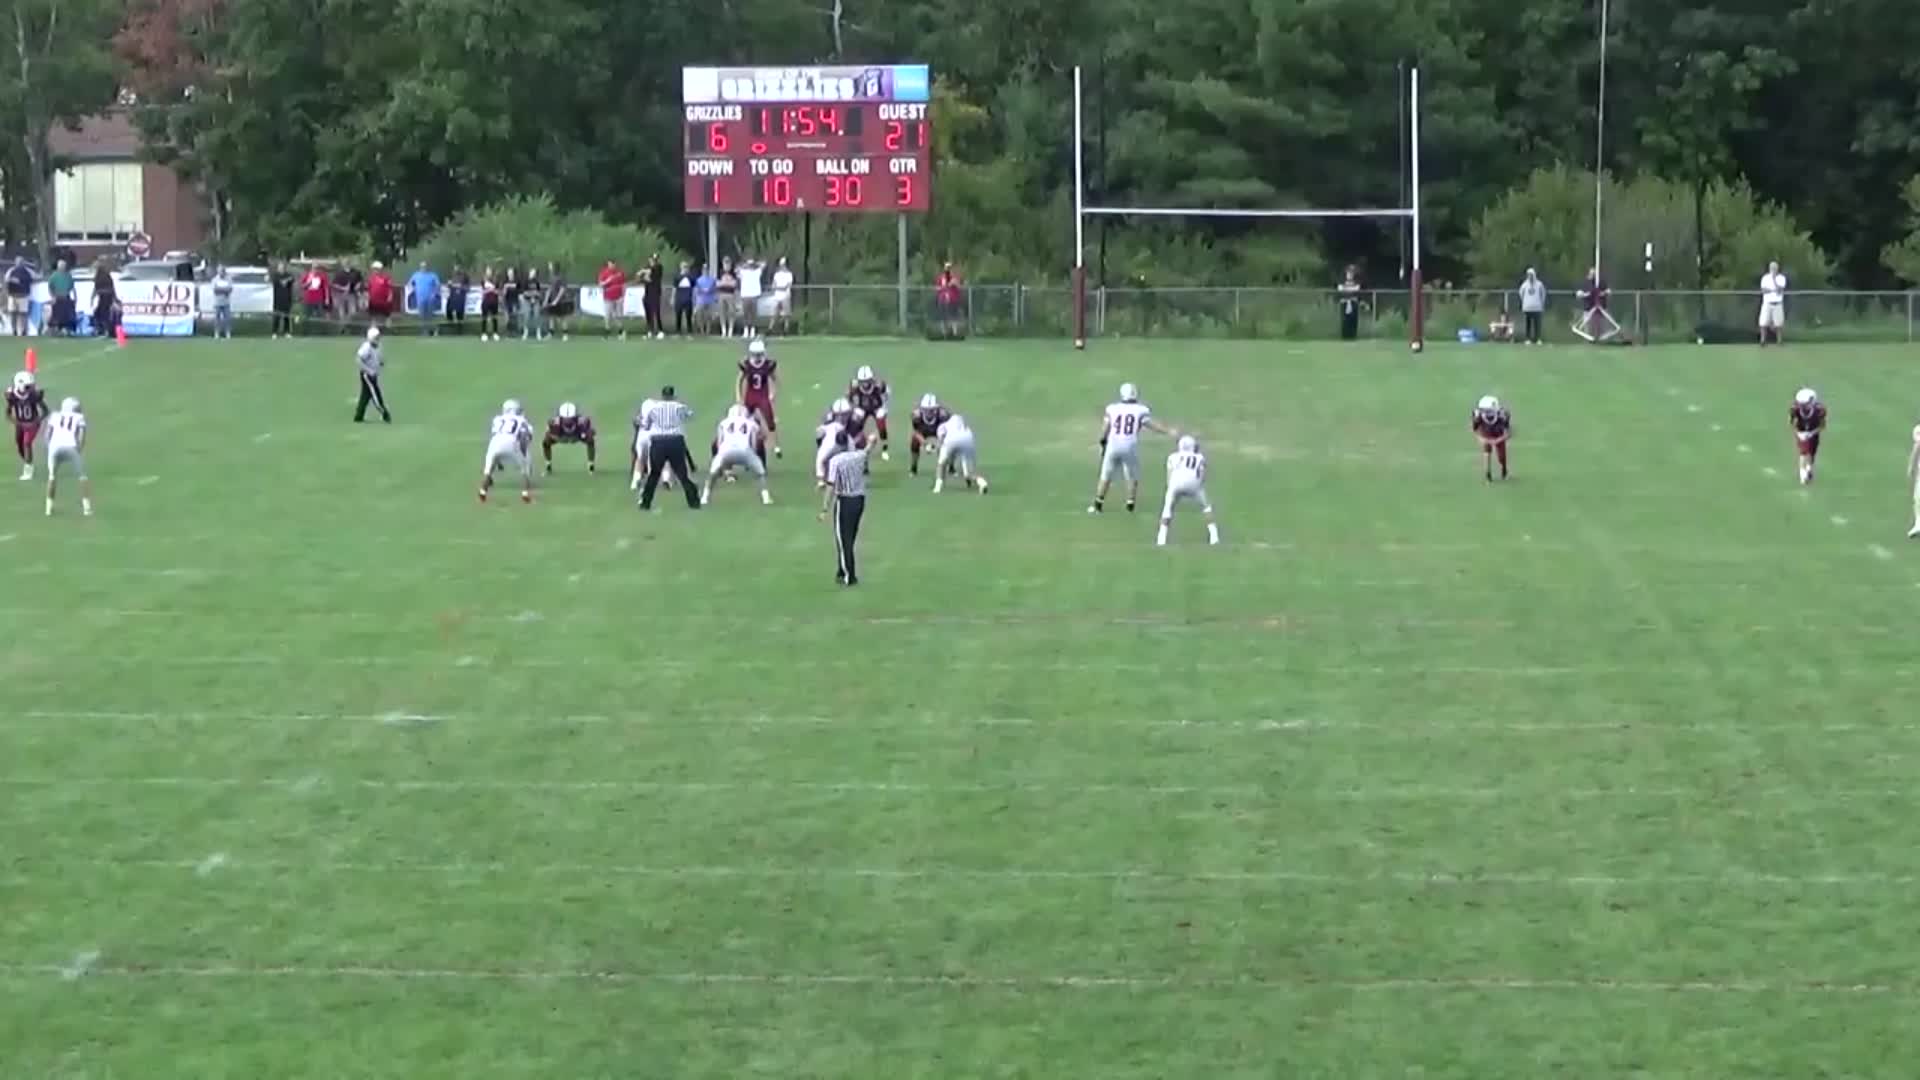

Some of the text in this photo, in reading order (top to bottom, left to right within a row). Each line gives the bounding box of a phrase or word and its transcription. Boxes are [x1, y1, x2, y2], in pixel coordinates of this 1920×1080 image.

[686, 105, 742, 121] GRIZZLIES
[879, 103, 926, 119] GUEST
[711, 122, 727, 151] 6
[886, 121, 923, 149] 21
[688, 160, 733, 175] DOWN
[749, 159, 793, 174] TO GO
[816, 159, 870, 174] BALL ON
[889, 158, 917, 173] QTR
[763, 177, 790, 205] 10
[826, 176, 861, 205] 30
[896, 176, 911, 205] 3
[753, 373, 762, 390] 3
[727, 422, 748, 435] 44
[1114, 414, 1135, 436] 48
